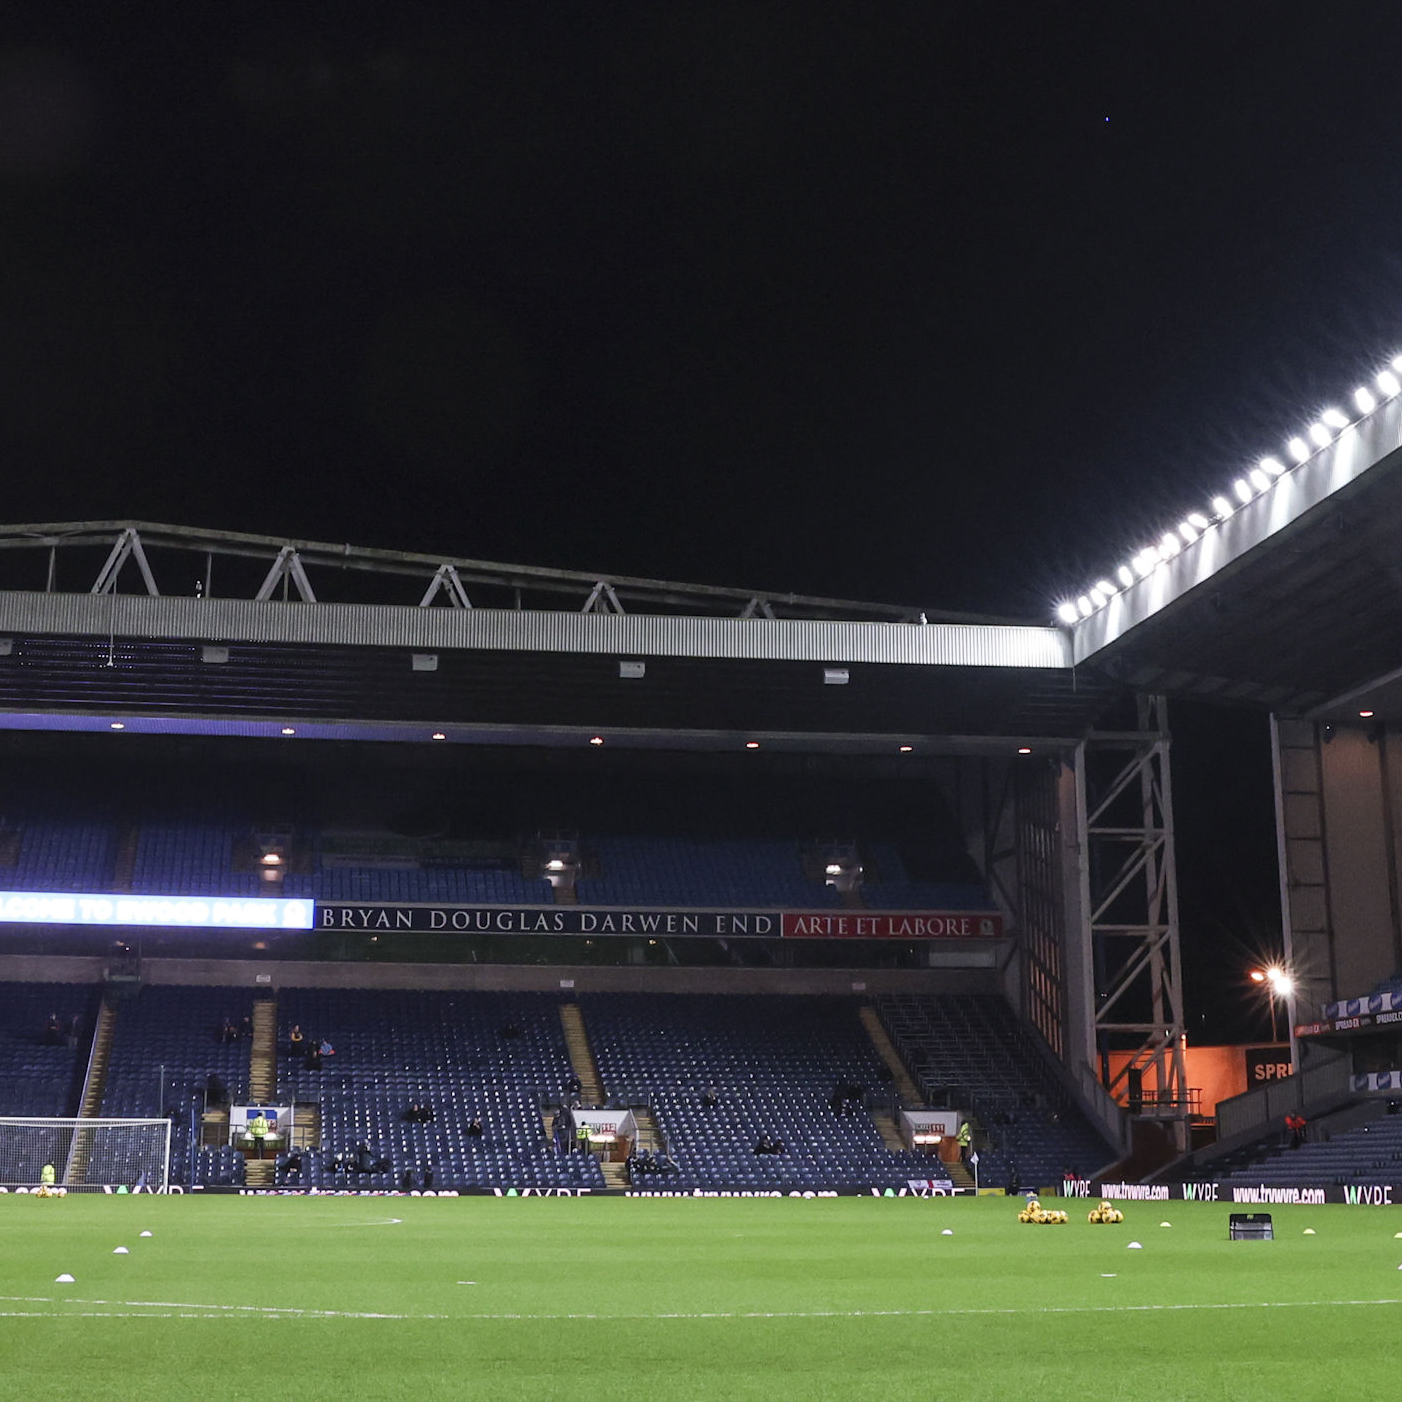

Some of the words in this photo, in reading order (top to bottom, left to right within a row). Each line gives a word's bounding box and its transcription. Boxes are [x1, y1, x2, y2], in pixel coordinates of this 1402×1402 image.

[322, 908, 413, 928] BRYAN
[430, 910, 564, 932] DOUGLAS
[581, 913, 699, 933] DARWEN
[716, 915, 772, 934] END
[794, 917, 848, 935] ARTE
[856, 917, 882, 935] ET
[888, 918, 971, 936] LABORE
